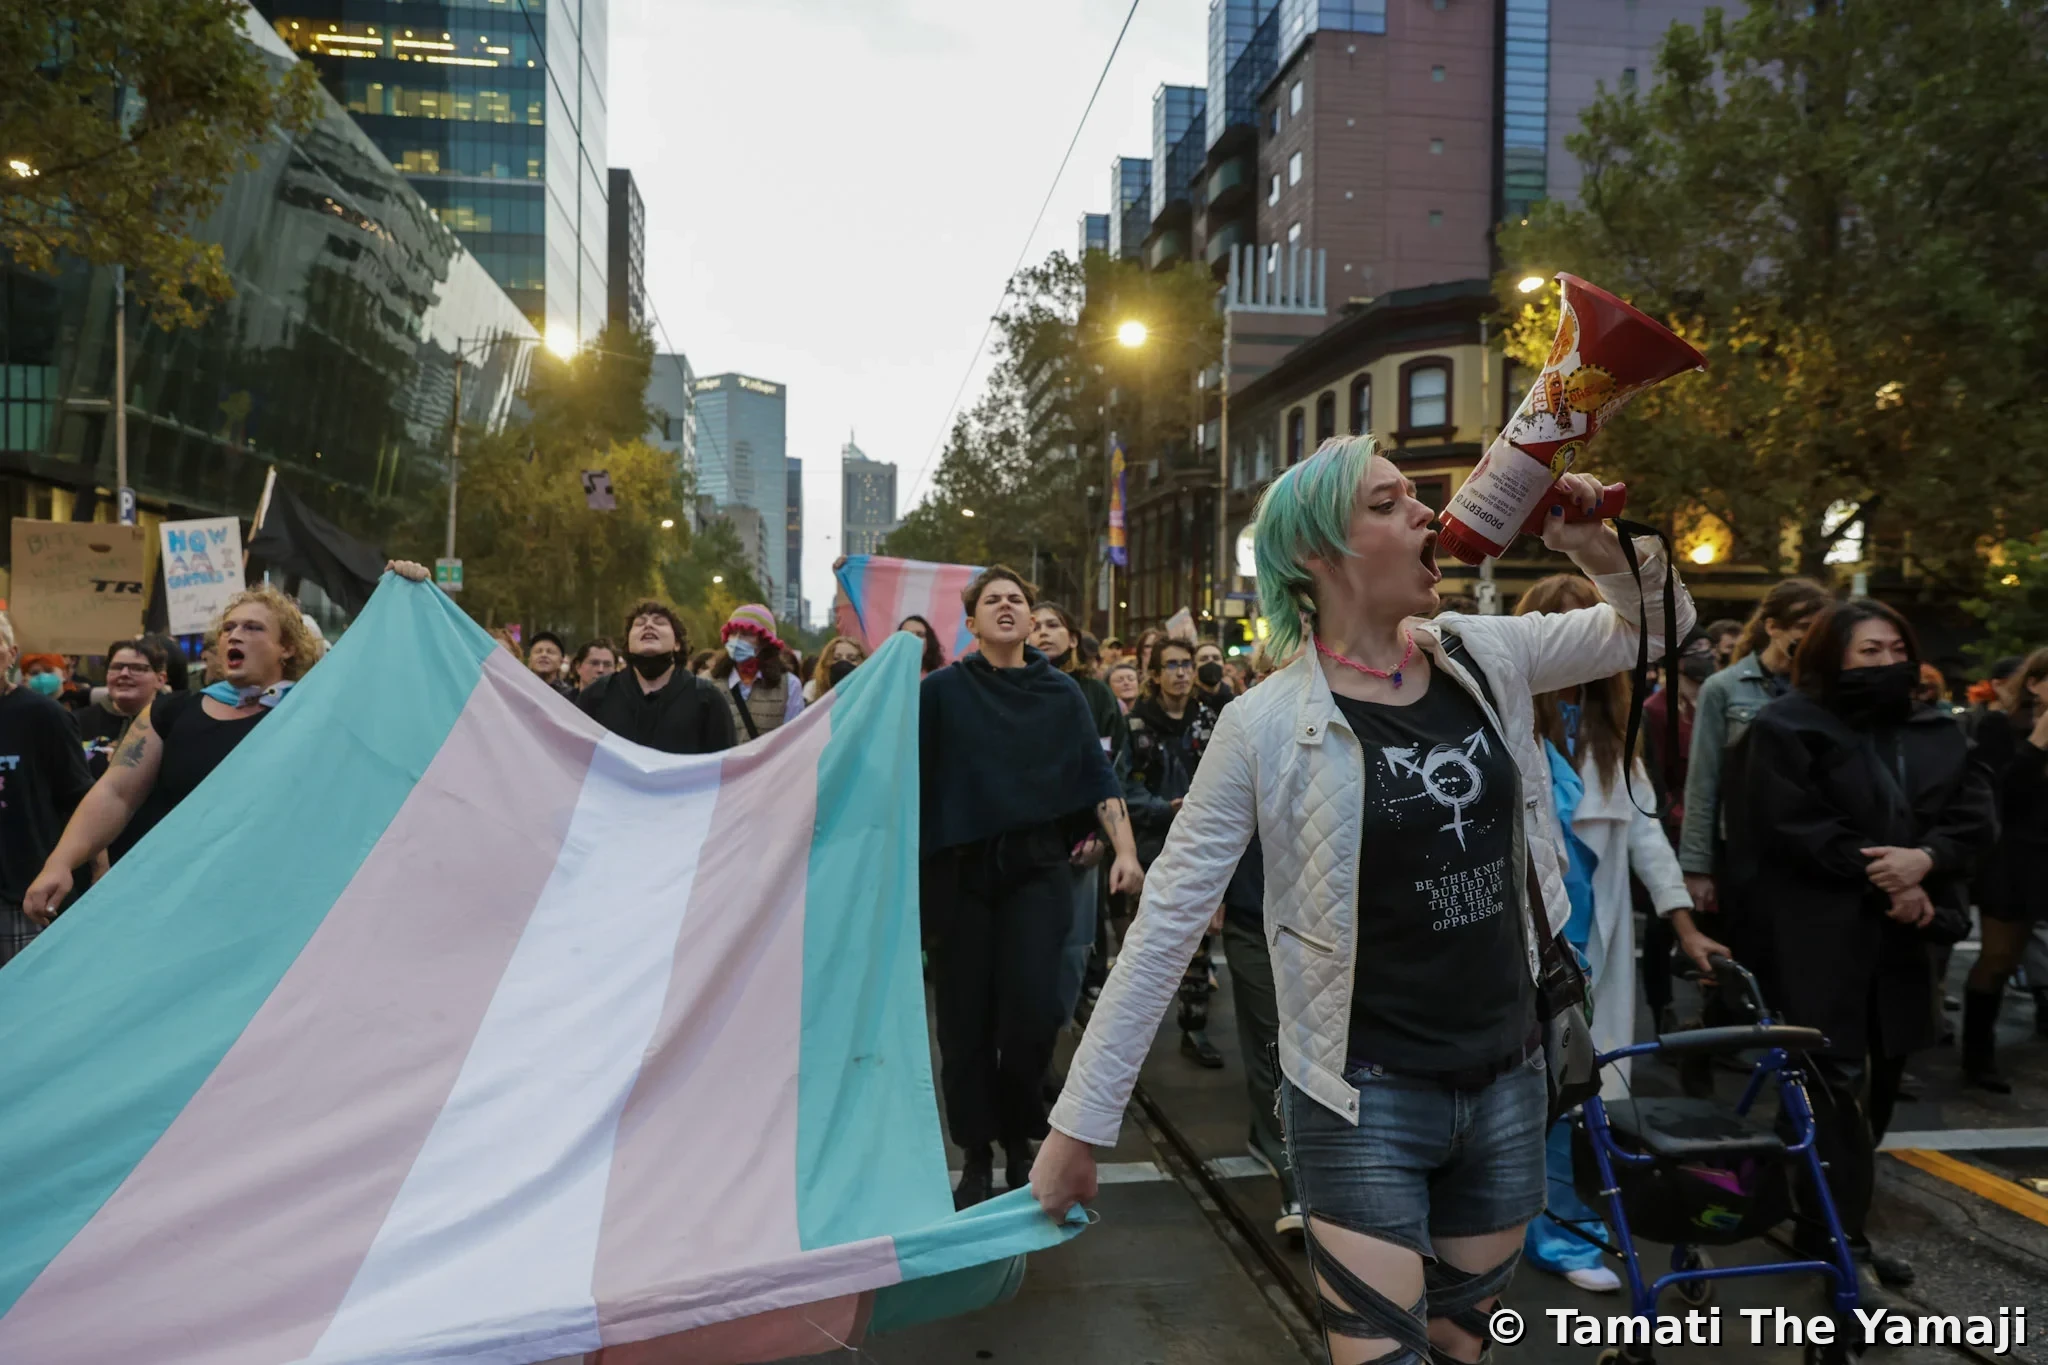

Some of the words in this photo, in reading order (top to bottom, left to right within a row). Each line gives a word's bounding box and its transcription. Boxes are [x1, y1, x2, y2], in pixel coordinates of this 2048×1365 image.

[1488, 472, 1504, 484] TRADES
[1498, 485, 1516, 499] RETURN
[121, 492, 133, 517] P
[1460, 496, 1505, 530] PROPERTY
[167, 525, 228, 553] HOW
[1415, 879, 1435, 892] BE
[1440, 871, 1468, 887] THE
[1474, 857, 1506, 879] KNIFE
[1432, 878, 1485, 900] BURIED
[1489, 870, 1501, 884] IN
[1428, 896, 1459, 911] THE
[1464, 881, 1504, 903] HEART
[1445, 905, 1462, 918] OF
[1468, 896, 1494, 912] THE
[1433, 901, 1504, 931] OPPRESSOR
